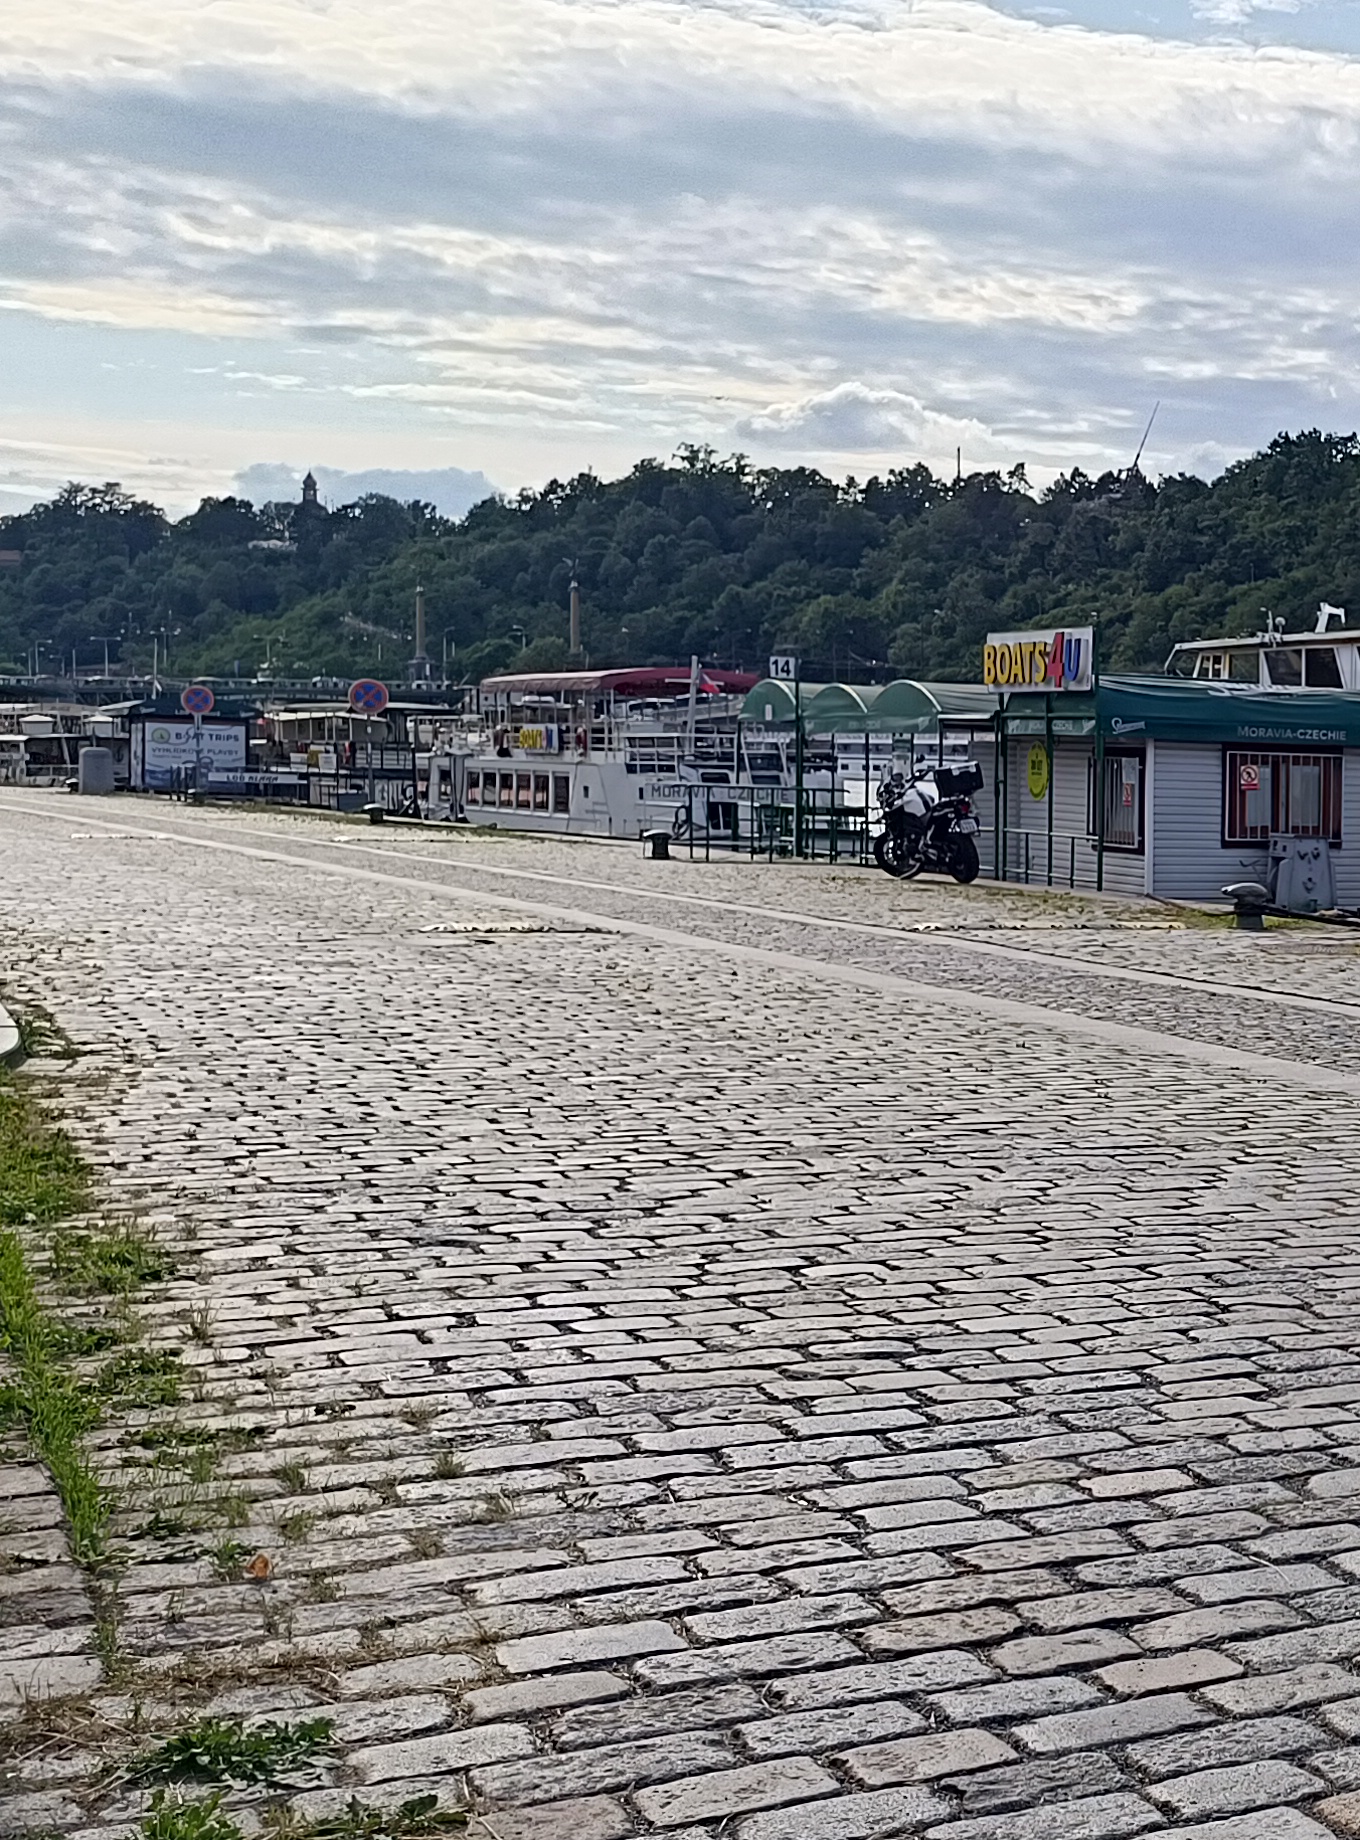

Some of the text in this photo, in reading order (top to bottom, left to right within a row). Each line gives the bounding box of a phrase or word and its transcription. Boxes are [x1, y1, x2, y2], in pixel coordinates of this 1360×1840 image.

[984, 631, 1081, 688] BOATS4U
[771, 659, 791, 677] 14
[208, 733, 240, 742] TRIPS
[1237, 726, 1347, 741] MORAVIA-CZECHIE
